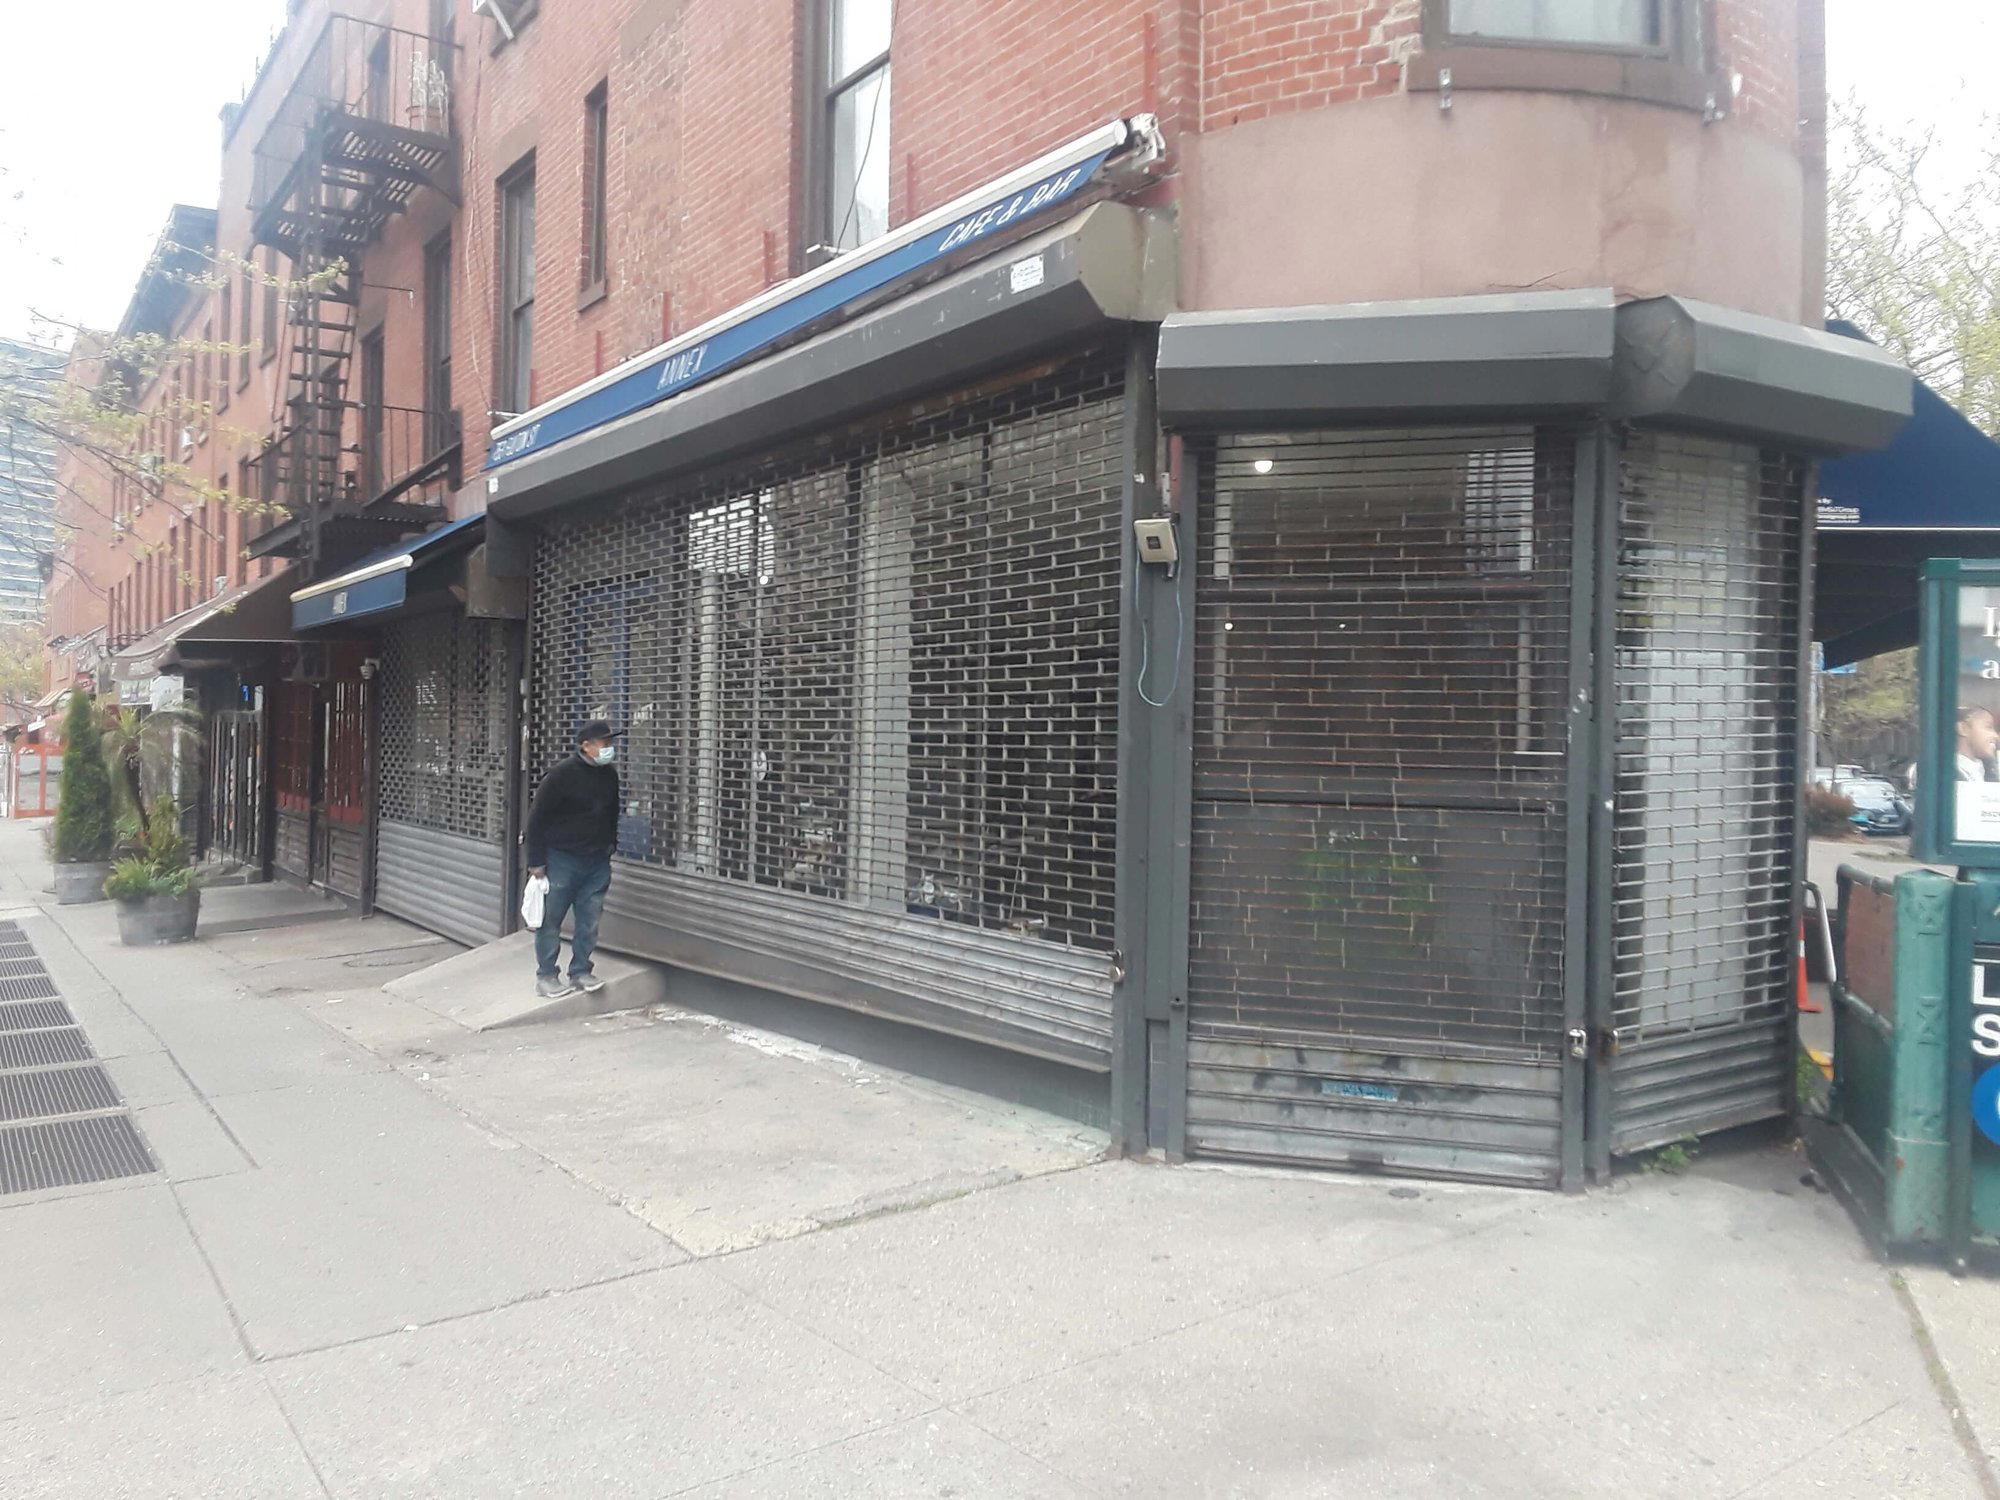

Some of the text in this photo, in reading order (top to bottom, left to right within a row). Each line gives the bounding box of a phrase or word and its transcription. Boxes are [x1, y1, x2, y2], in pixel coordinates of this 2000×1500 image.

[938, 168, 1081, 252] CAFE & BAR
[656, 344, 708, 390] ANNEX
